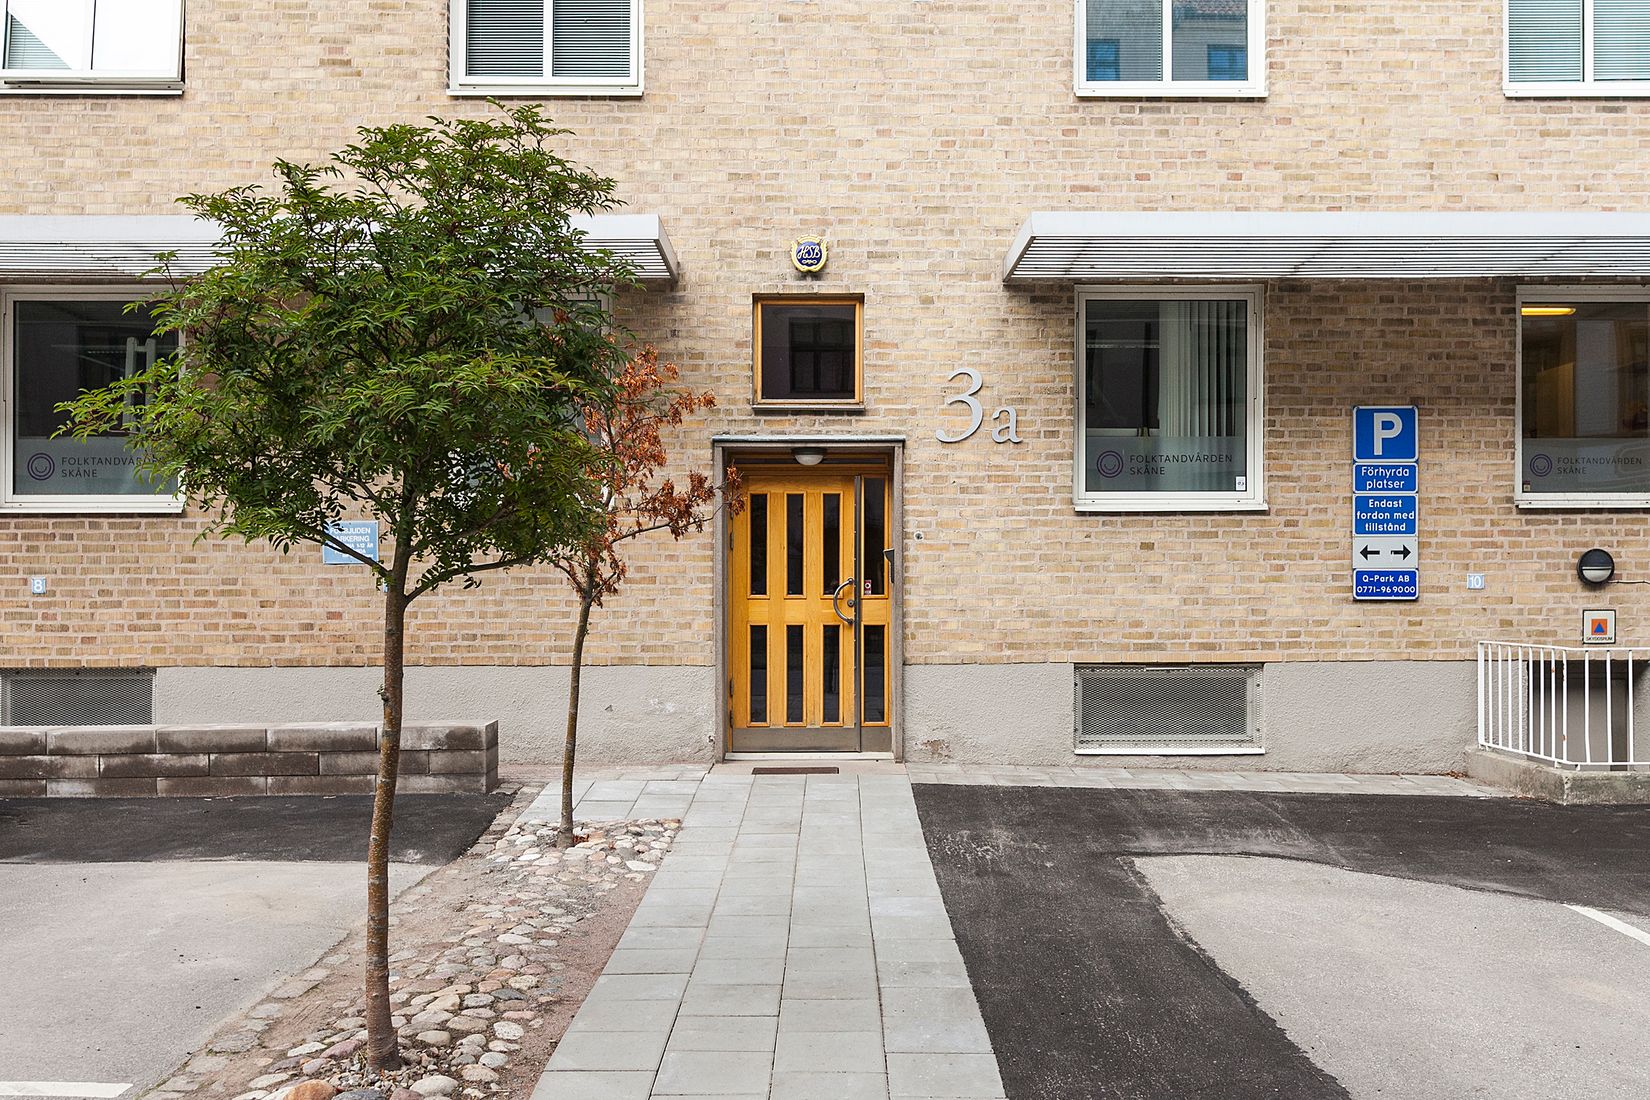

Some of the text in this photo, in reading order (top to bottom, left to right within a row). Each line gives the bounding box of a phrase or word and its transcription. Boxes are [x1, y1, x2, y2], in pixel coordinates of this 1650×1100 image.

[1373, 412, 1403, 456] P
[1130, 452, 1233, 463] FOLKTANDVÅRDEN
[1557, 455, 1642, 465] FOLKTANDVÅRDEN
[61, 467, 98, 478] SKÅNE
[1130, 464, 1165, 475] SKÅNE
[1361, 466, 1409, 478] Förhyrda
[1557, 465, 1587, 475] SKÅNE
[1366, 479, 1404, 491] platser
[1368, 499, 1402, 508] Endast
[1357, 511, 1415, 520] fordon med
[1365, 522, 1406, 531] tillstånd
[1362, 574, 1394, 582] Q-Park
[1469, 576, 1482, 588] 10
[34, 579, 43, 592] 8
